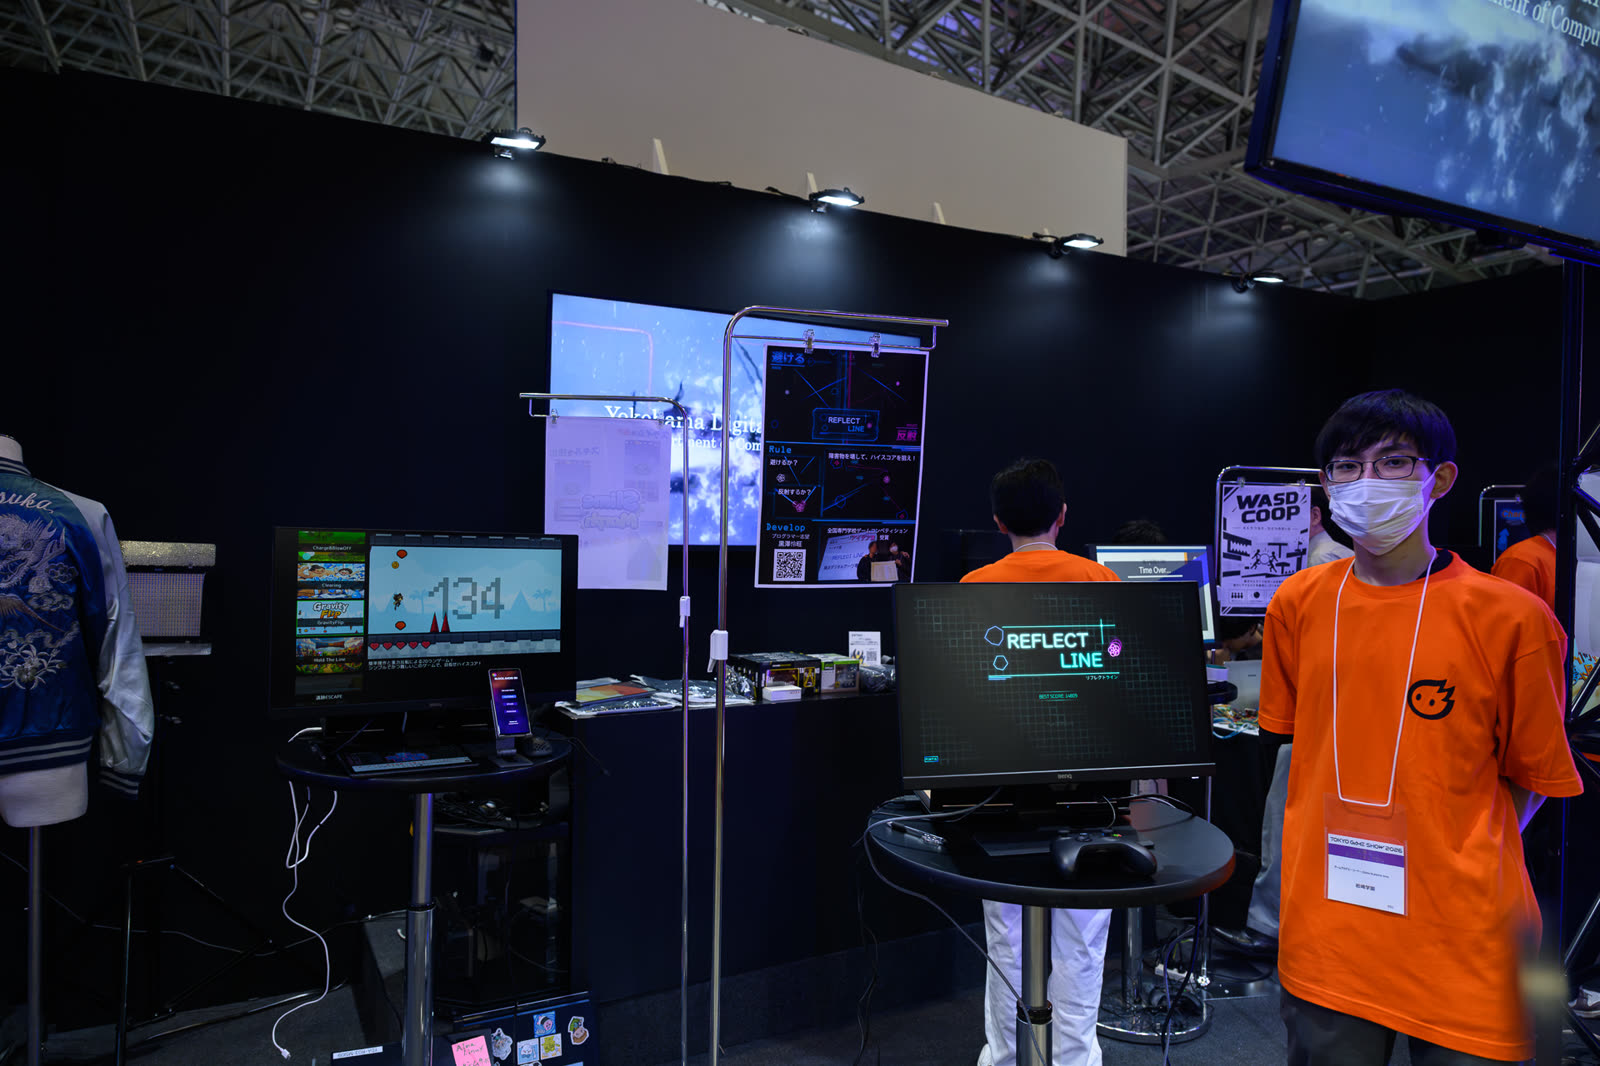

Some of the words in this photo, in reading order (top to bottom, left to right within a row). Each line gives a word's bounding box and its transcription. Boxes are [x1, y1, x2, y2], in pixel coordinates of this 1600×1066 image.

[1532, 0, 1551, 24] of
[771, 351, 805, 364] 避ける
[828, 416, 861, 425] REFLECT
[847, 425, 865, 433] LINE
[896, 430, 918, 441] 反射
[769, 445, 792, 454] Rule
[1236, 491, 1299, 510] WASD
[1241, 505, 1301, 524] COOP
[766, 523, 806, 533] Develop
[1138, 566, 1153, 574] Time
[428, 577, 504, 620] 134
[313, 602, 349, 614] Gravity
[320, 609, 342, 619] Flip
[1007, 632, 1089, 649] REFLECT
[1059, 652, 1104, 669] LINE
[1330, 836, 1349, 845] TOKYO
[1366, 842, 1385, 850] SHOW
